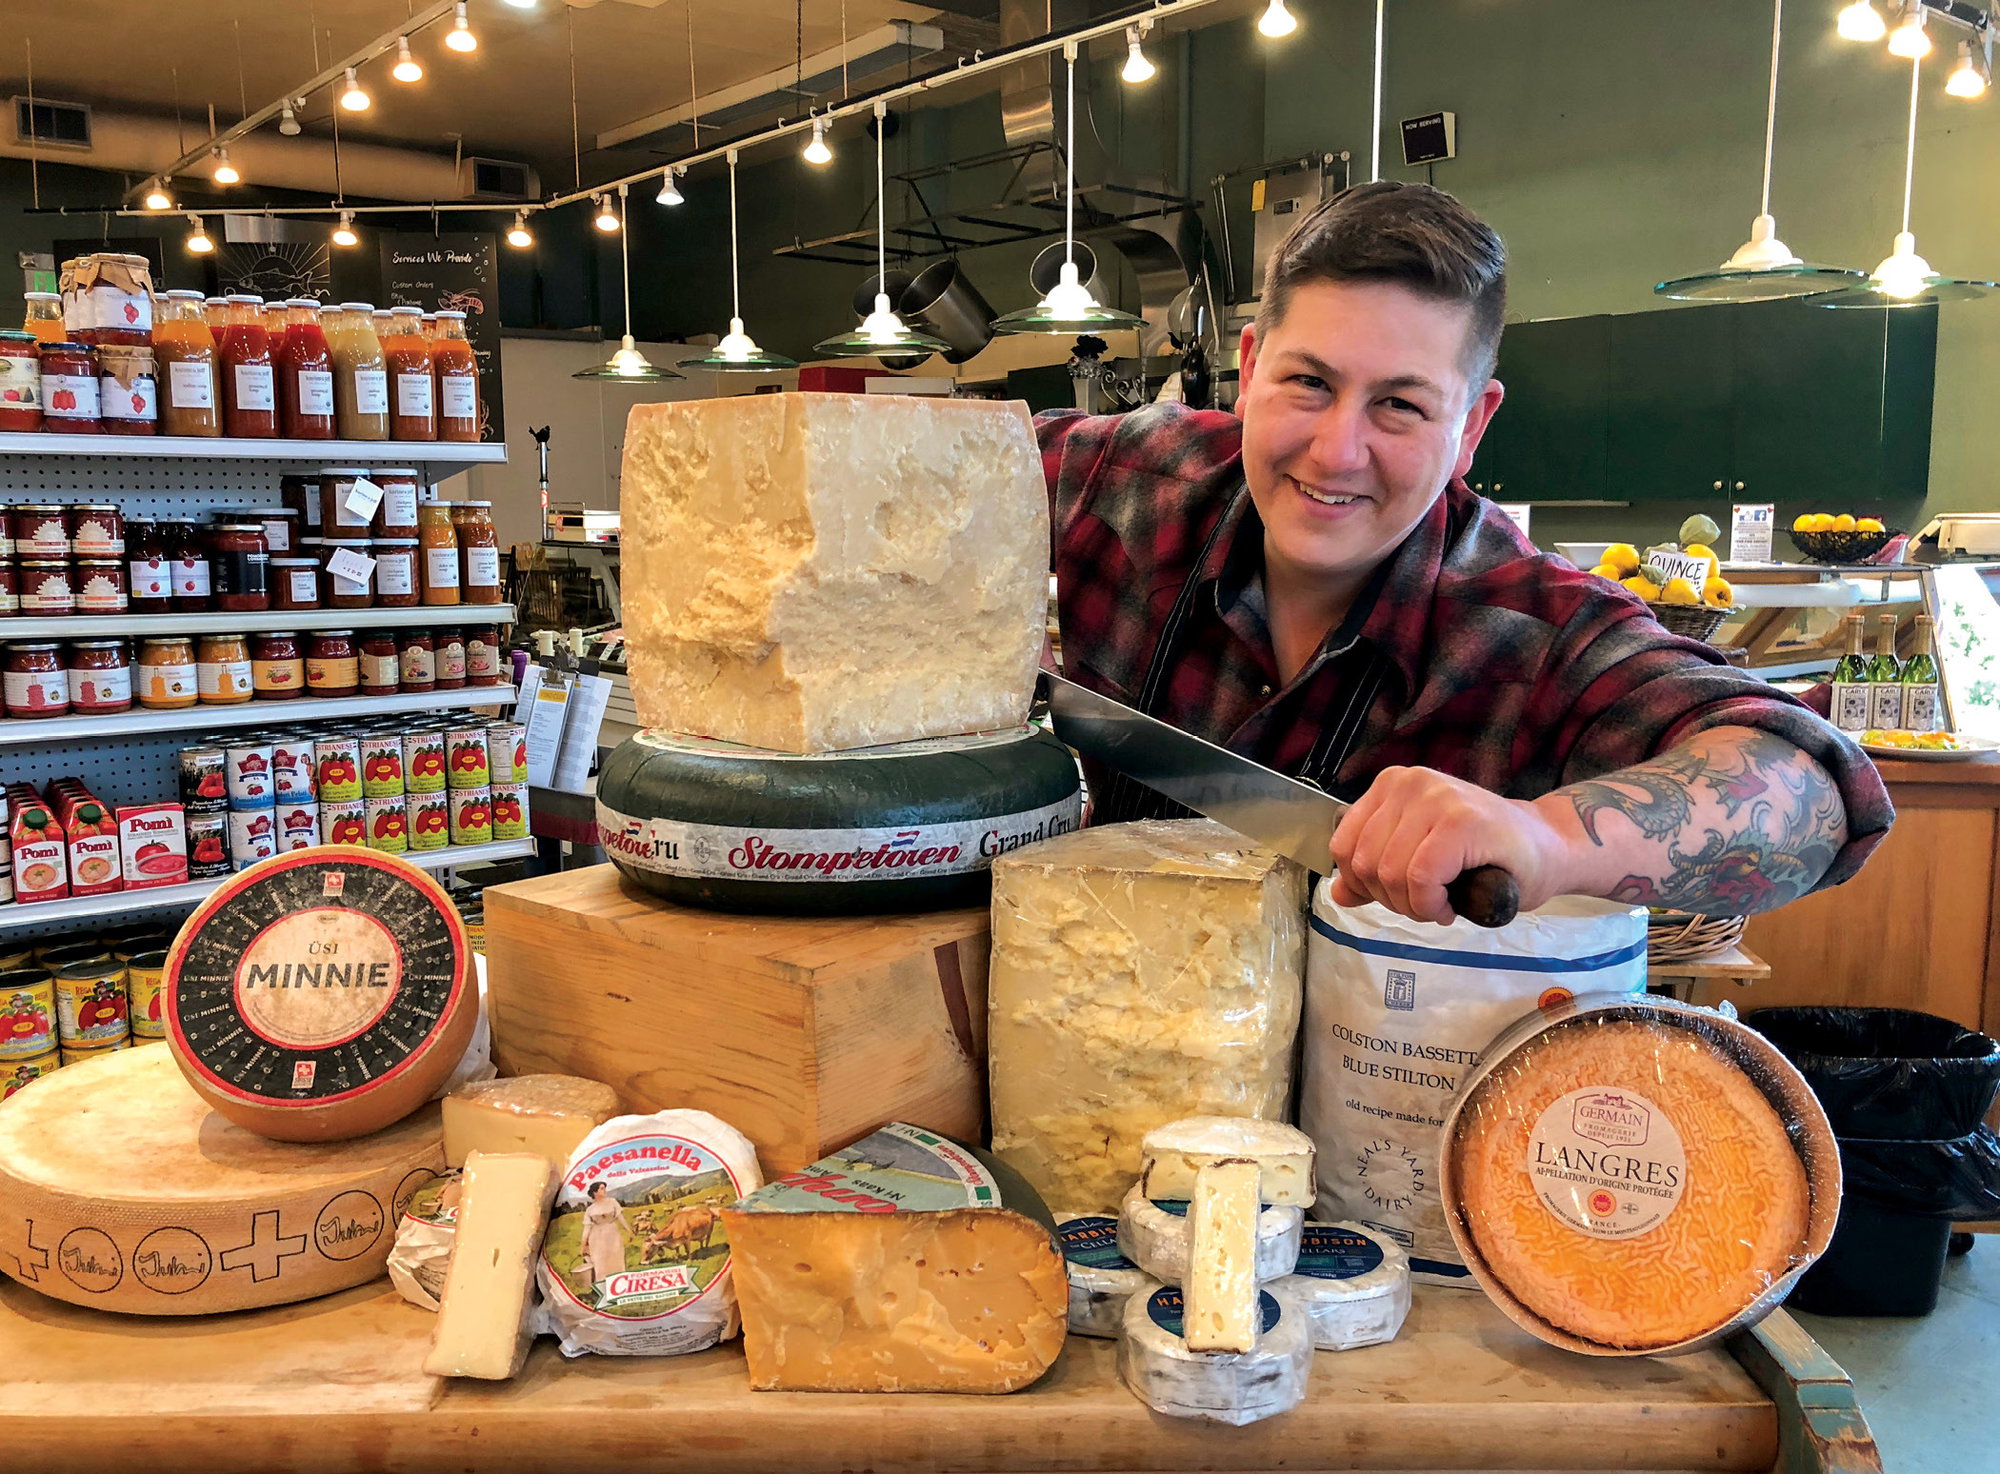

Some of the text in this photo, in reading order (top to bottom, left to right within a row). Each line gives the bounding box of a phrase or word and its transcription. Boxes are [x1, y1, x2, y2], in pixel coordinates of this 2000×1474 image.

[129, 816, 174, 833] Pomì
[20, 846, 59, 861] Pomì
[76, 839, 113, 854] Pomì
[728, 814, 1071, 876] Stompetoren Grand Cru
[308, 940, 339, 955] ÜSI
[246, 963, 390, 989] MINNIE
[200, 1002, 231, 1017] MINNIE
[217, 1026, 244, 1048] MINNIE
[1332, 1023, 1478, 1066] COLSTON BASSETT
[245, 1045, 268, 1070] MINNIE
[1343, 1054, 1456, 1091] BLUE STILTON
[1345, 1099, 1445, 1128] old recipe made for
[1580, 1105, 1644, 1127] GERMAIN
[1583, 1123, 1637, 1138] FROMAGERIE
[1587, 1130, 1614, 1140] DEPUIS
[568, 1144, 702, 1192] Paesanella
[1357, 1138, 1391, 1178] NEAL'S
[1400, 1146, 1425, 1192] YARD
[1535, 1141, 1680, 1188] LANGRES
[852, 1180, 886, 1195] Kaas
[1535, 1166, 1674, 1200] APPELLATION D'ORIGINE PROTÉGÉE
[1364, 1186, 1413, 1211] DAIRY
[610, 1272, 687, 1297] CIRESA
